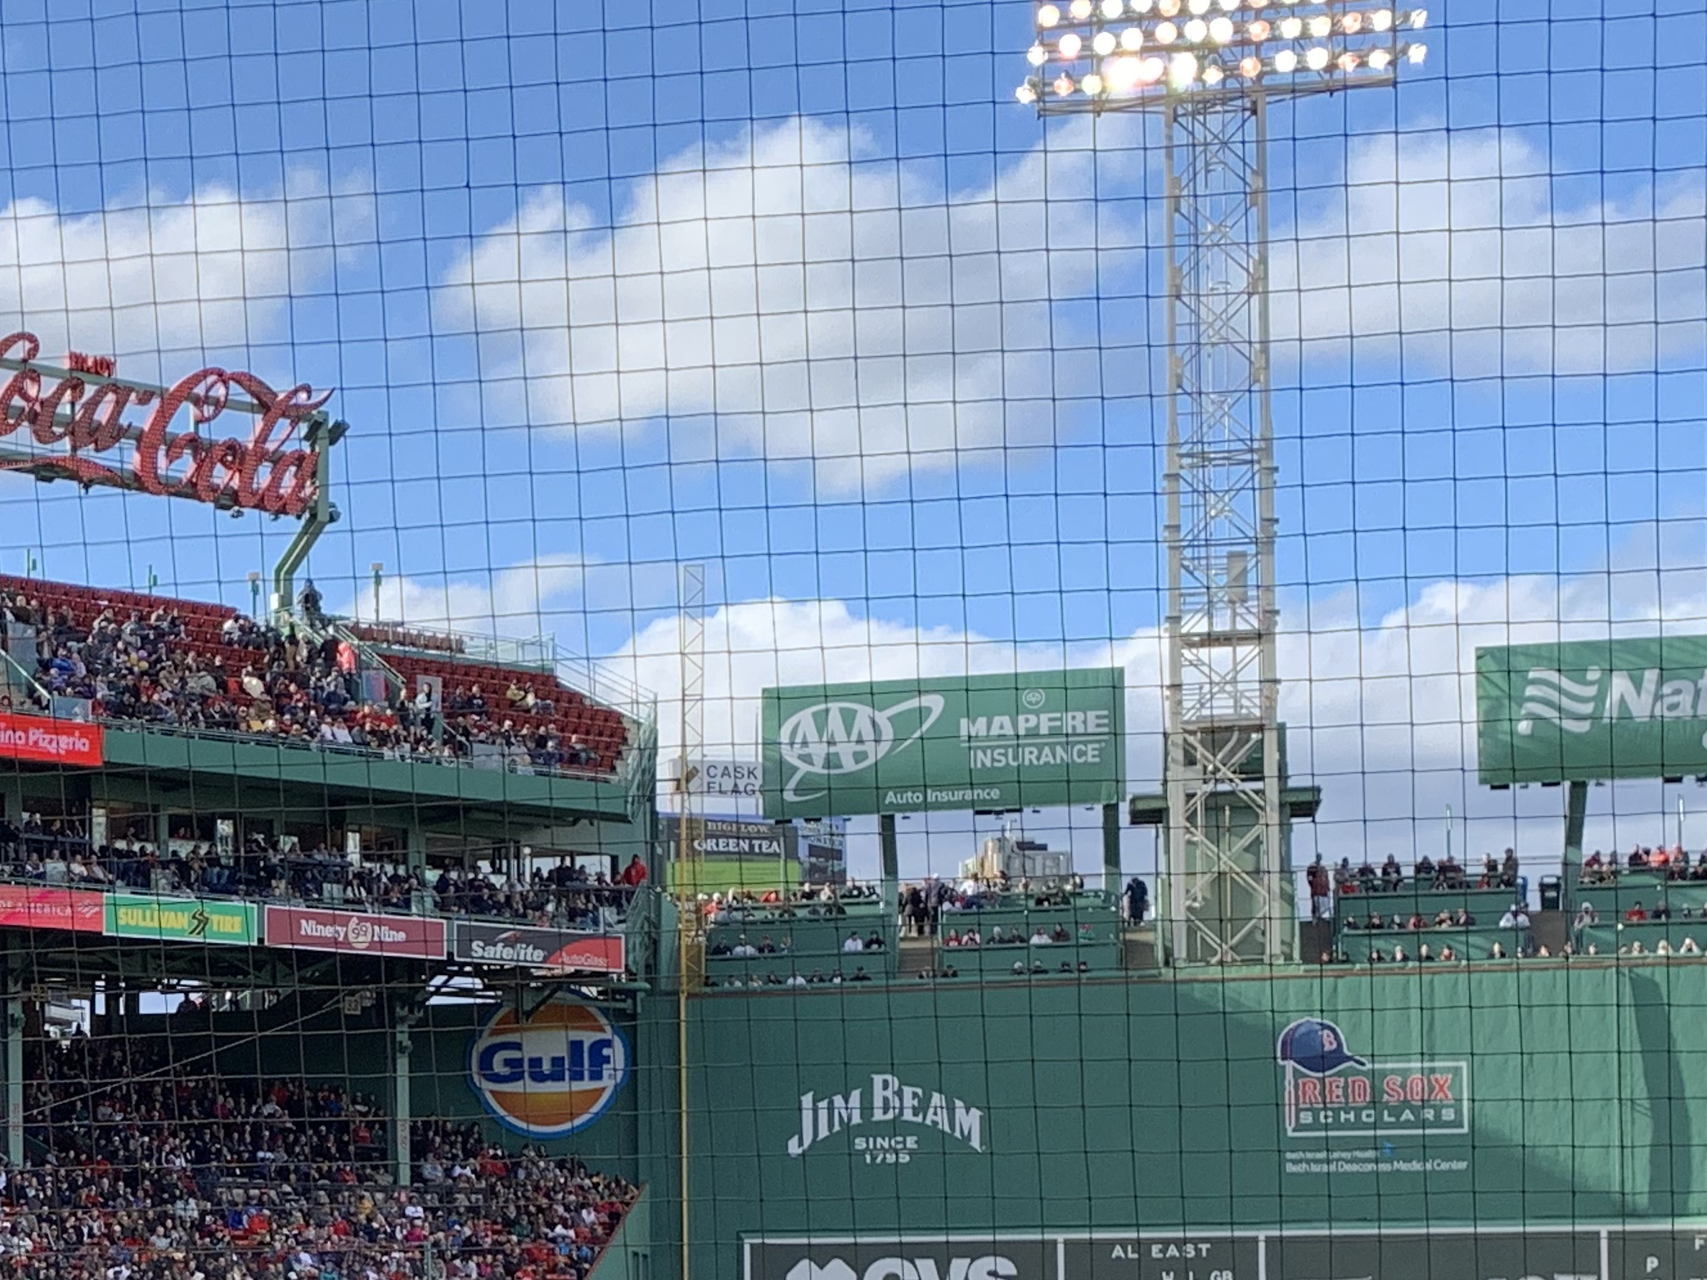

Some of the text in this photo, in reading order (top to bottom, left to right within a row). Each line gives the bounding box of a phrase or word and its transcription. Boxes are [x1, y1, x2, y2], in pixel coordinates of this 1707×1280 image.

[959, 709, 1111, 741] MAPFRE
[970, 743, 1102, 770] INSURANCE
[706, 764, 759, 781] CASK
[706, 782, 763, 797] FLAG
[884, 786, 1001, 806] Auto Insurance
[694, 837, 781, 854] GREEN TEA
[117, 906, 243, 934] SULLIVAN TIRE
[300, 918, 346, 941] Ninety
[373, 924, 407, 943] Nine
[470, 939, 546, 963] Safelite
[478, 1038, 615, 1084] Gulf
[1298, 1073, 1455, 1108] RED SOX
[787, 1073, 985, 1158] JIM BEAM
[1298, 1107, 1456, 1125] SCHOLARS
[854, 1135, 919, 1150] SINCE
[864, 1150, 911, 1165] 1795
[1285, 1161, 1310, 1173] Beth
[1393, 1159, 1433, 1172] Medical
[1433, 1158, 1469, 1171] Center
[1111, 1243, 1212, 1260] AL EAST
[1645, 1256, 1660, 1273] P
